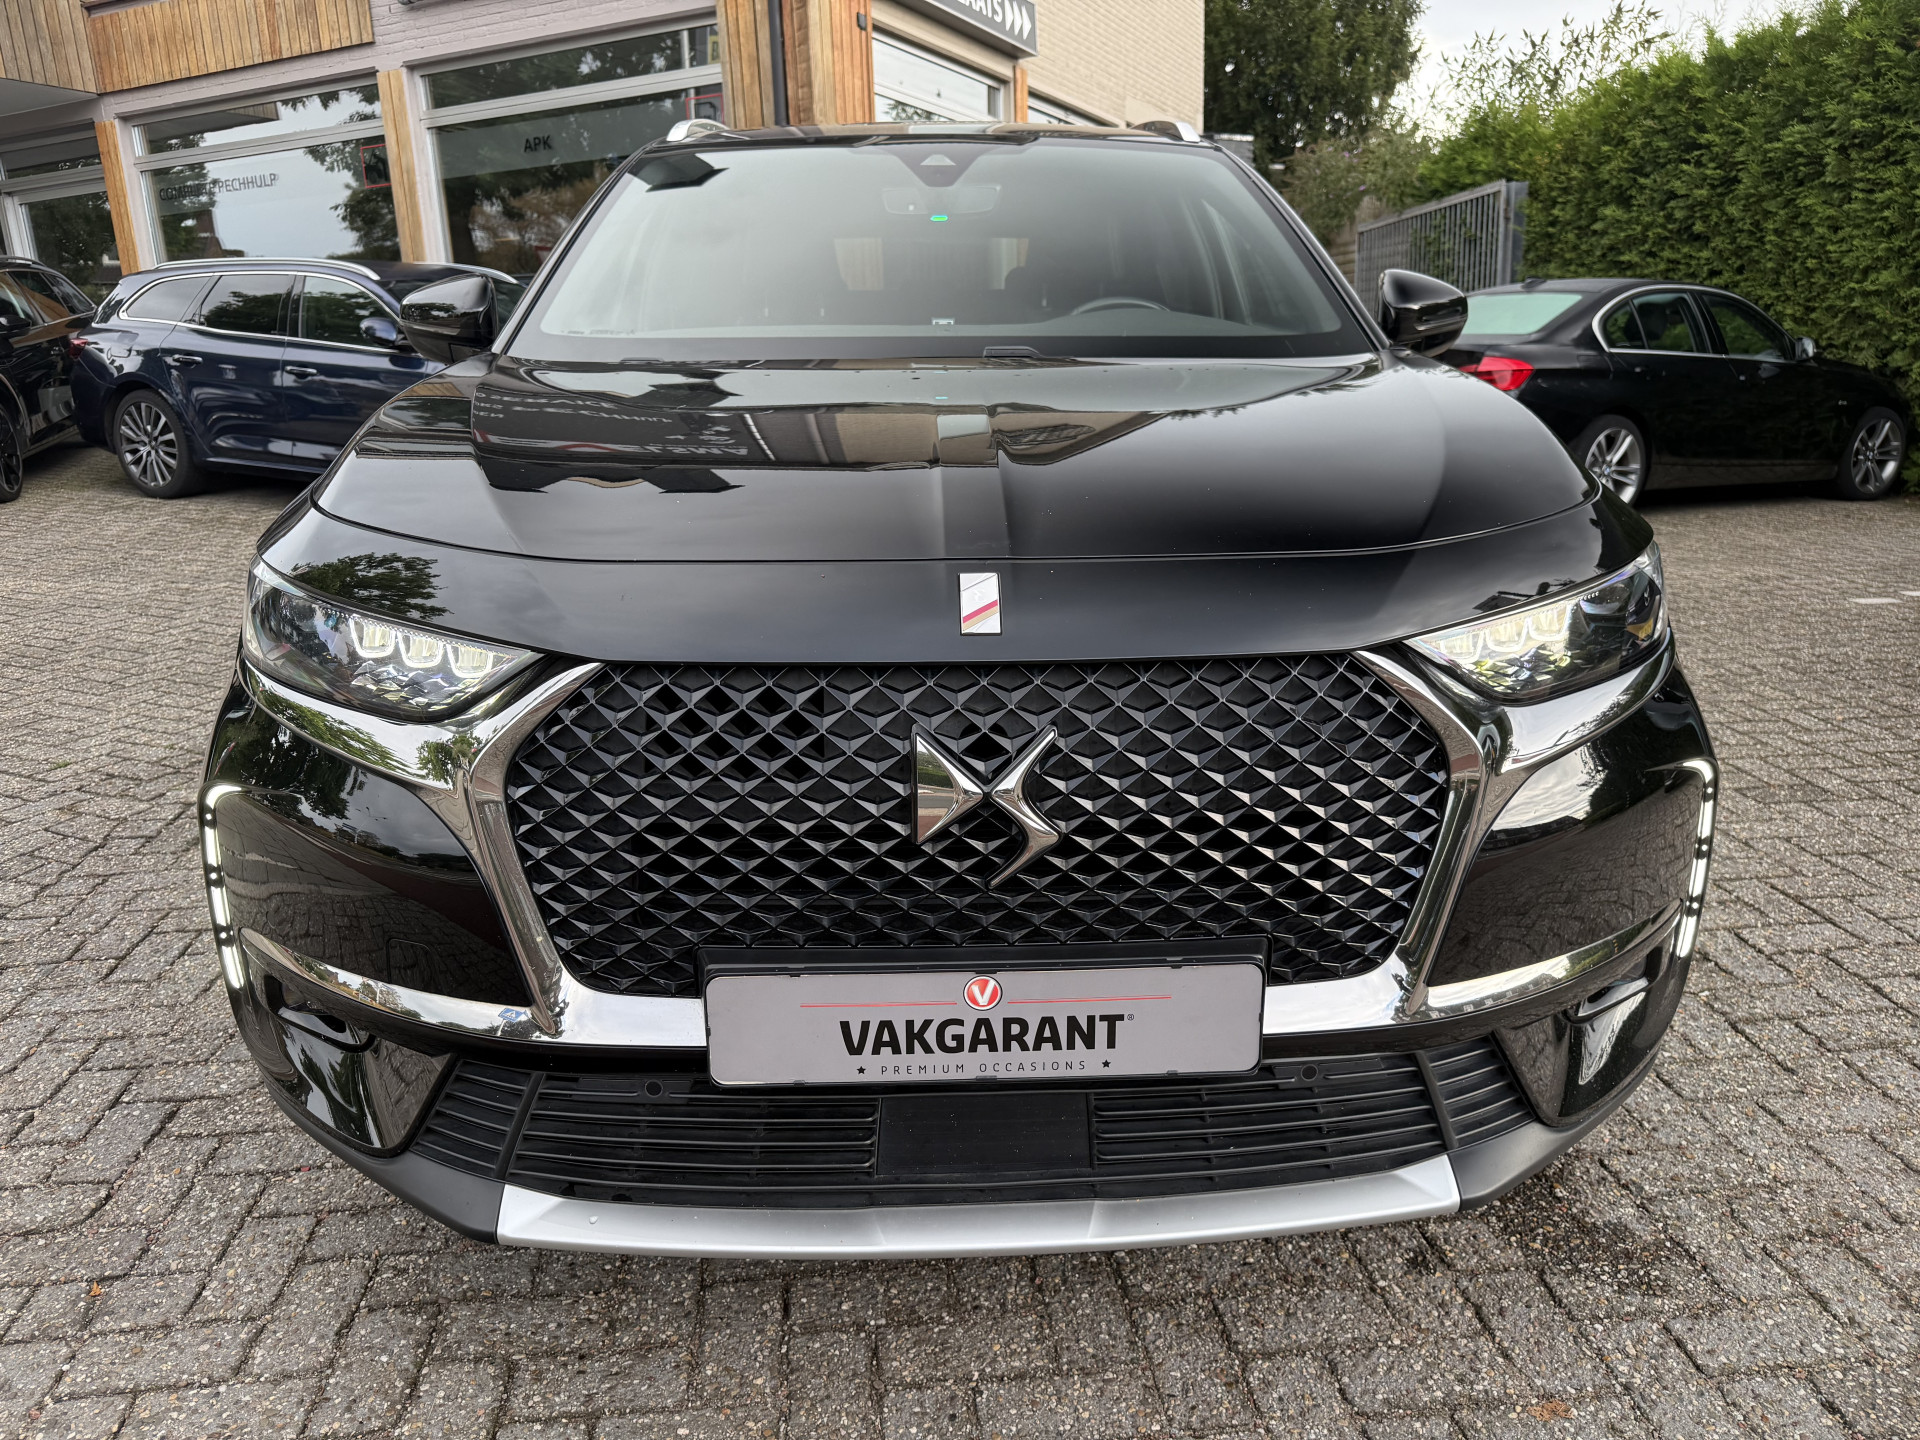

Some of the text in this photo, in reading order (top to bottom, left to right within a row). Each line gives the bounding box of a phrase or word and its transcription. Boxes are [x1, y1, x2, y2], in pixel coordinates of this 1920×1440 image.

[524, 134, 552, 153] APK
[218, 173, 278, 193] PECHHULP
[881, 1060, 1086, 1075] PREMIUM OCCASIONS
